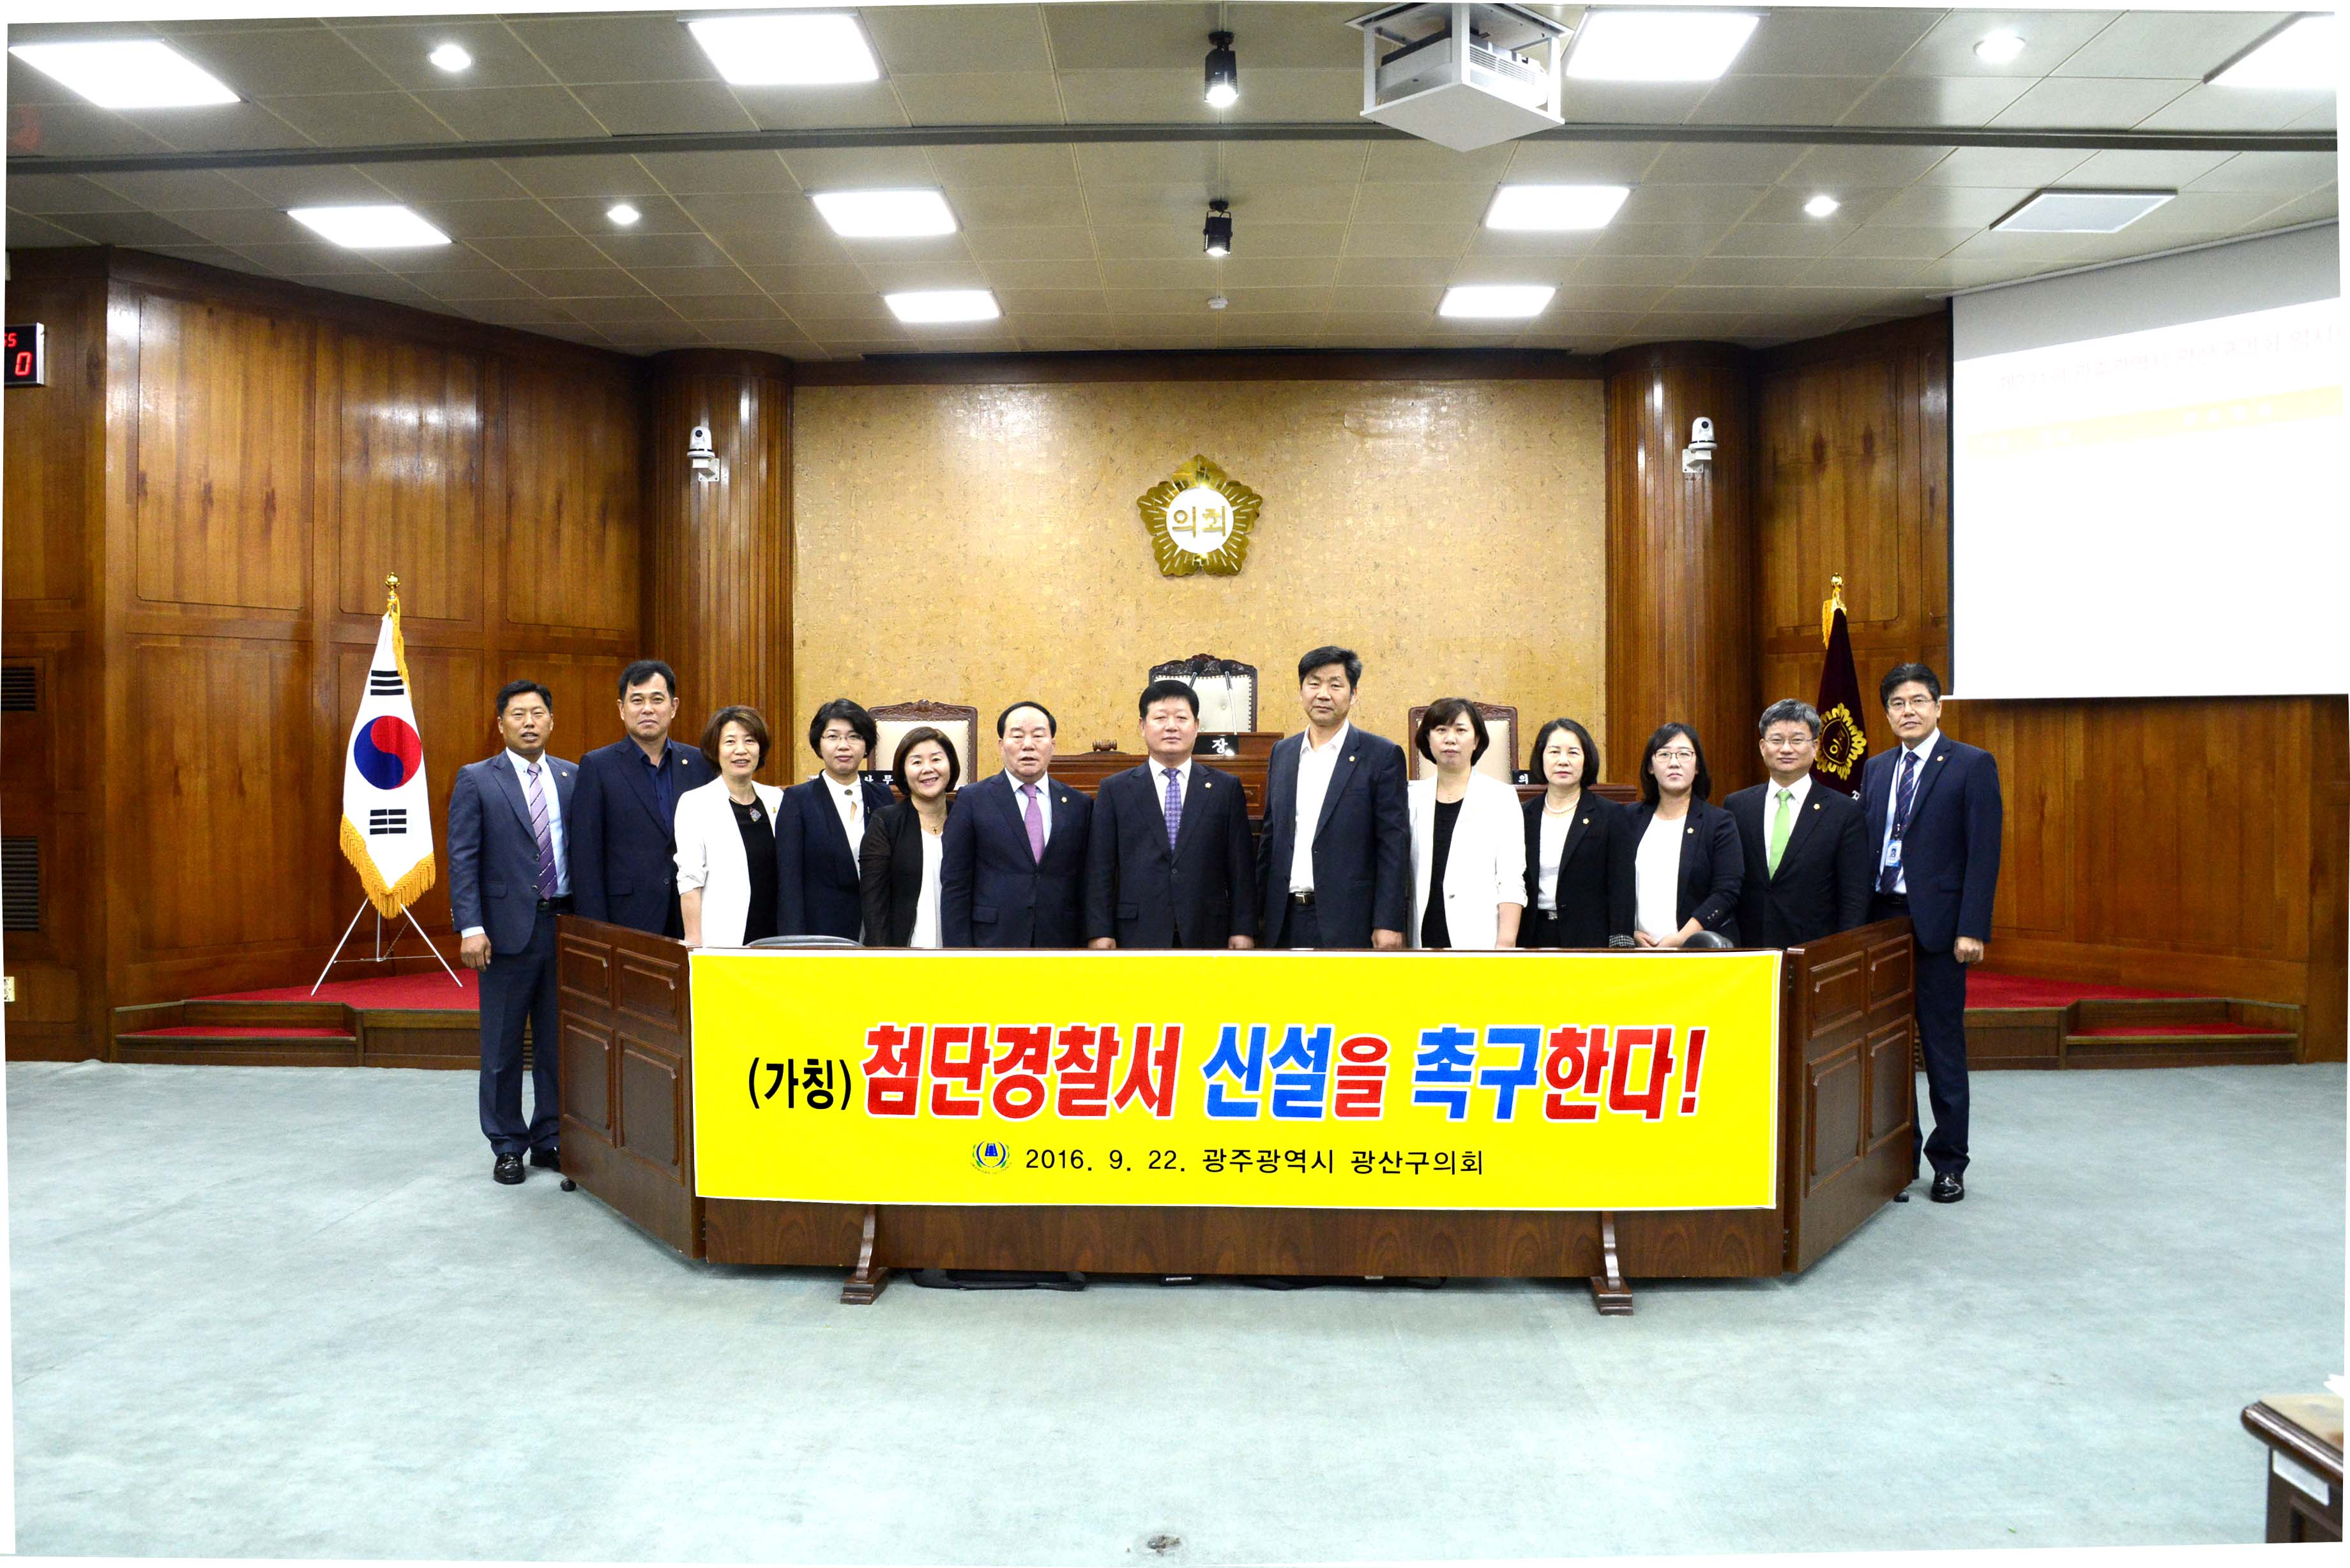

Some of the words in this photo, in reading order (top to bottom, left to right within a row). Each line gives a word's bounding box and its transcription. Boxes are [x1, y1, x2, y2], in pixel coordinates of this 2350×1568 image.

[14, 351, 33, 377] 0
[1172, 505, 1226, 538] 의회
[1211, 737, 1229, 754] 장
[1518, 773, 1529, 785] 의
[748, 1056, 852, 1112] (가칭)
[861, 1024, 1182, 1120] 첨단경찰서
[1201, 1025, 1389, 1120] 신설을
[1413, 1026, 1708, 1121] 촉구한다!
[1025, 1148, 1093, 1172] 2016.
[1109, 1149, 1132, 1172] 9.
[1148, 1149, 1186, 1173] 22.
[1202, 1147, 1333, 1175] 광주광역시
[1350, 1149, 1483, 1176] 광산구의회
